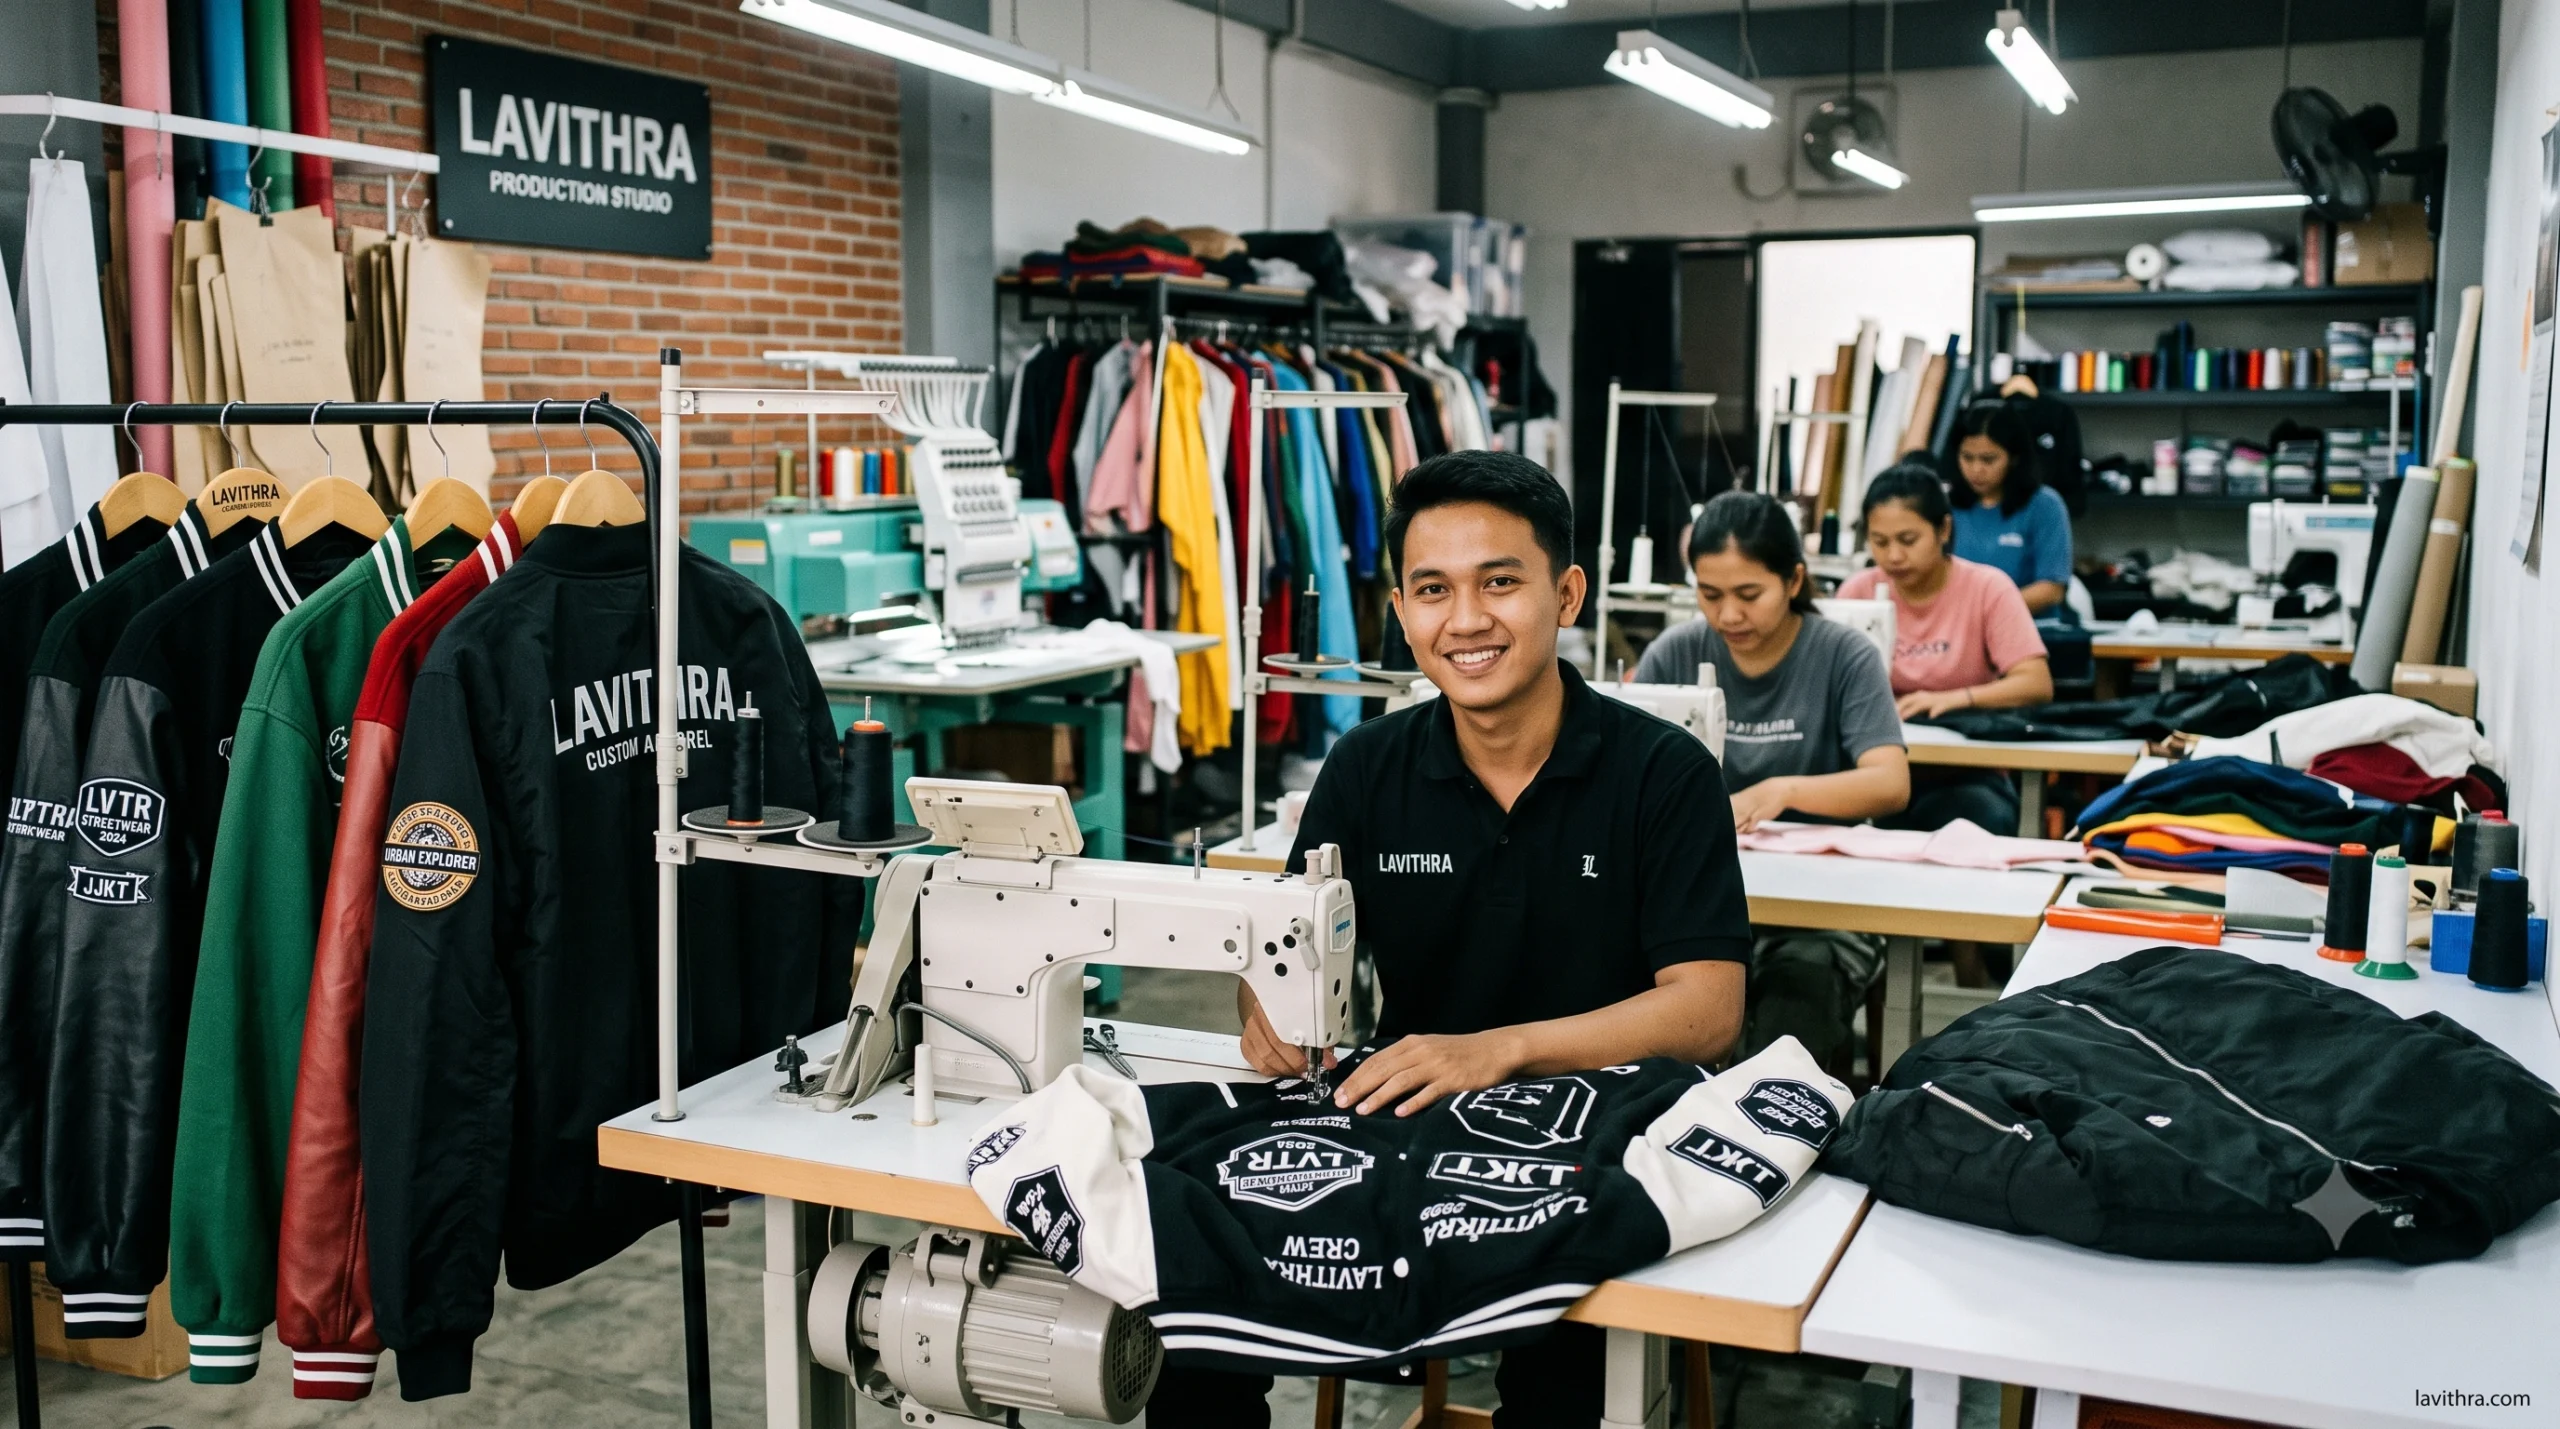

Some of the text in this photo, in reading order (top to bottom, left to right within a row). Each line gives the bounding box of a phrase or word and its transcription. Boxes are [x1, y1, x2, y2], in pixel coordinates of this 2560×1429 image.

[458, 87, 698, 184] LAVITHRA
[489, 170, 673, 214] PRODUCTION STUDIO
[211, 483, 280, 506] LAVITHRA
[586, 737, 639, 771] CUSTOM
[85, 786, 152, 821] LVTR
[81, 814, 152, 835] STREETWEAR
[98, 830, 128, 845] 2024
[384, 847, 477, 871] URBAN EXPLORER
[1379, 853, 1454, 873] LAVITHRA
[83, 876, 130, 900] JJKT
[1247, 1150, 1344, 1172] LVTR
[1281, 1235, 1361, 1261] CREW
[1263, 1256, 1384, 1290] LAVITHRA
